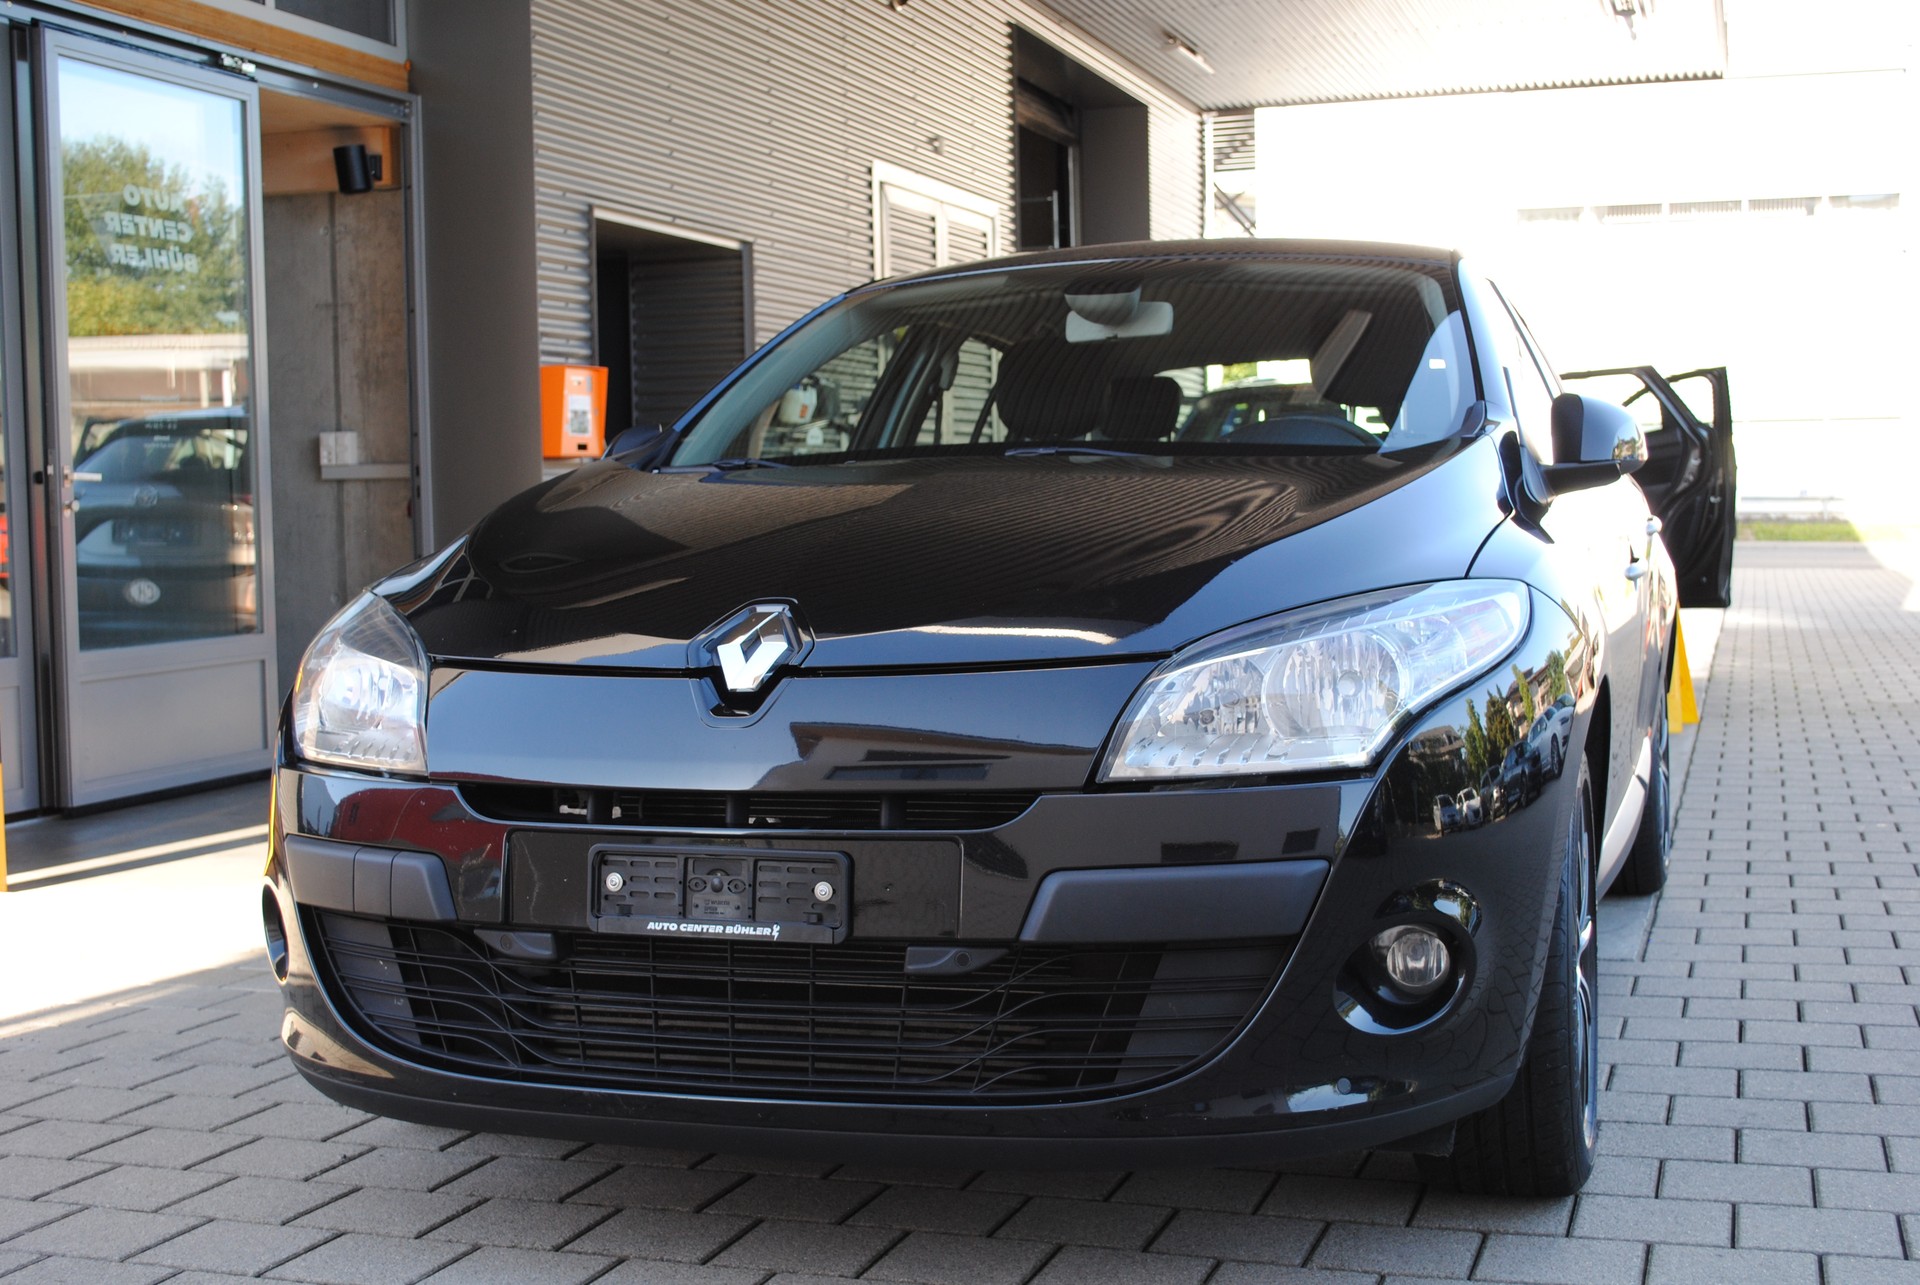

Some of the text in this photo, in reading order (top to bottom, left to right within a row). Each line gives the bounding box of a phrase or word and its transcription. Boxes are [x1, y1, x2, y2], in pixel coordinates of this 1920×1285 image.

[647, 921, 772, 935] AUTO CENTER BÜHLER
